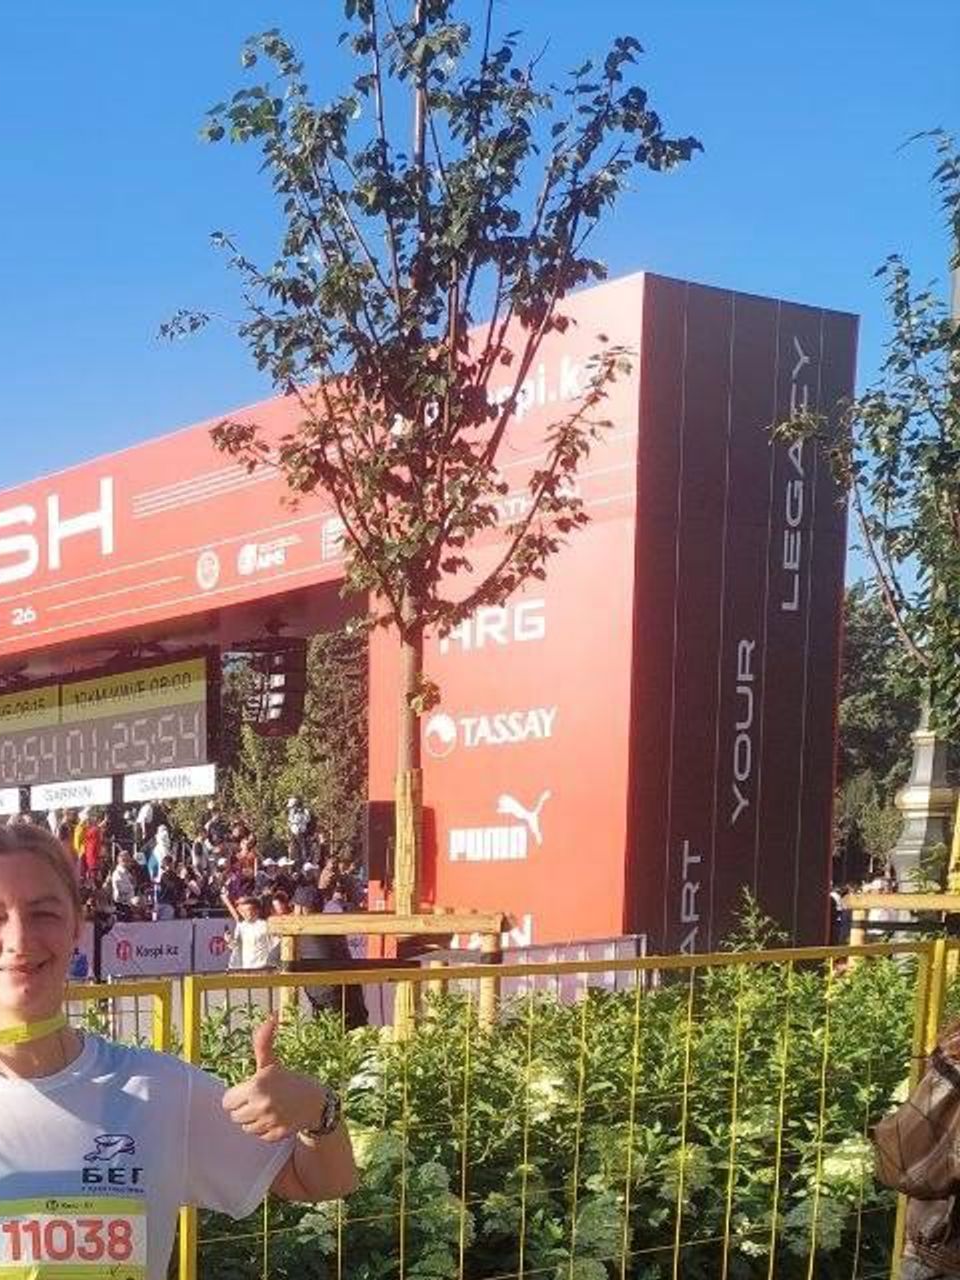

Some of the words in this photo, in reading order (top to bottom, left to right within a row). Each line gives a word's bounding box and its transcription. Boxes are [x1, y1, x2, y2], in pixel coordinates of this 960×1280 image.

[782, 335, 810, 611] LEGACY
[11, 606, 37, 626] 26
[461, 704, 558, 747] TASSAY
[731, 638, 755, 825] YOUR
[448, 825, 528, 861] PUMA
[1, 1218, 134, 1262] 11038
